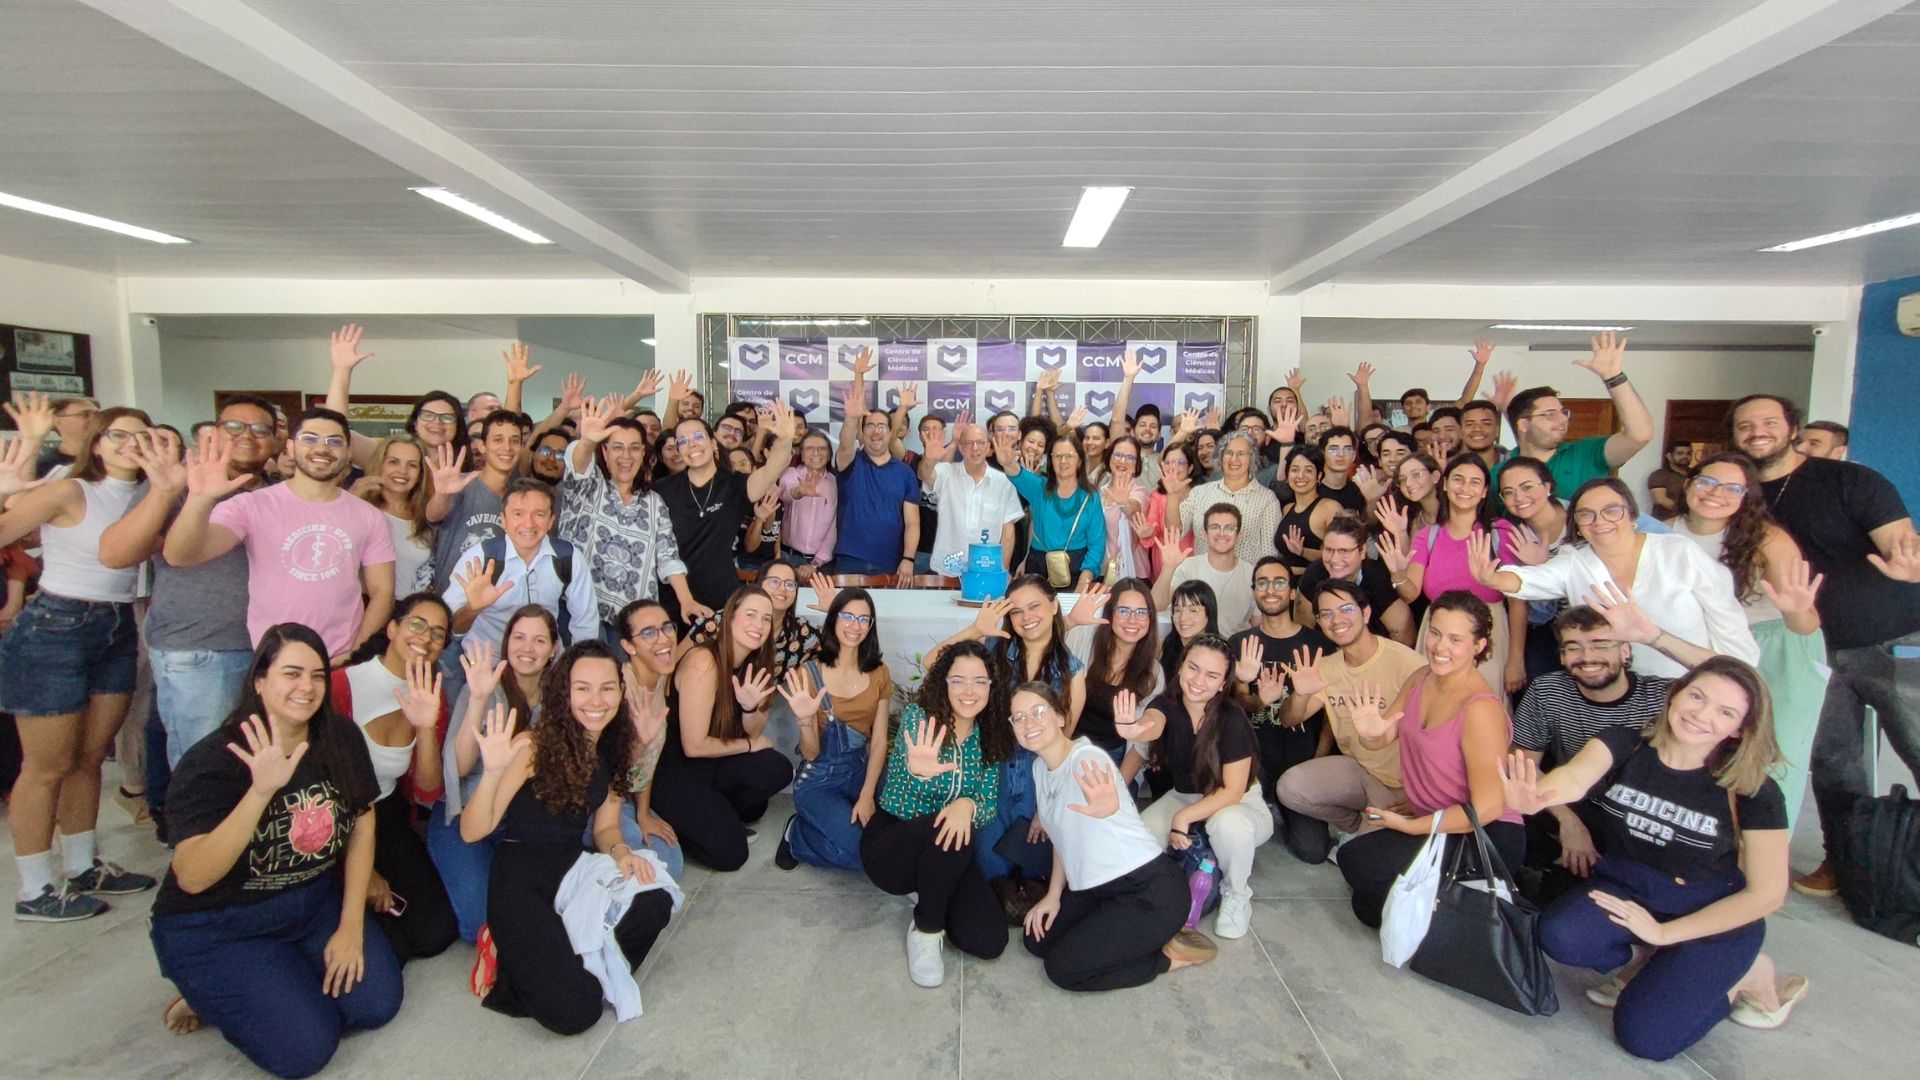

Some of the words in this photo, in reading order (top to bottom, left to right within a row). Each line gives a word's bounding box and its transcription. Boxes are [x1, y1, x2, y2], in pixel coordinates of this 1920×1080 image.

[885, 348, 910, 356] Centro
[911, 348, 921, 356] de
[785, 353, 823, 365] CCM
[887, 356, 919, 364] Ciências
[1082, 356, 1120, 368] CCM
[736, 389, 762, 397] Centro
[763, 389, 774, 397] de
[933, 398, 970, 410] CCM
[1605, 783, 1719, 836] MEDICINA
[1626, 812, 1675, 841] UFPB
